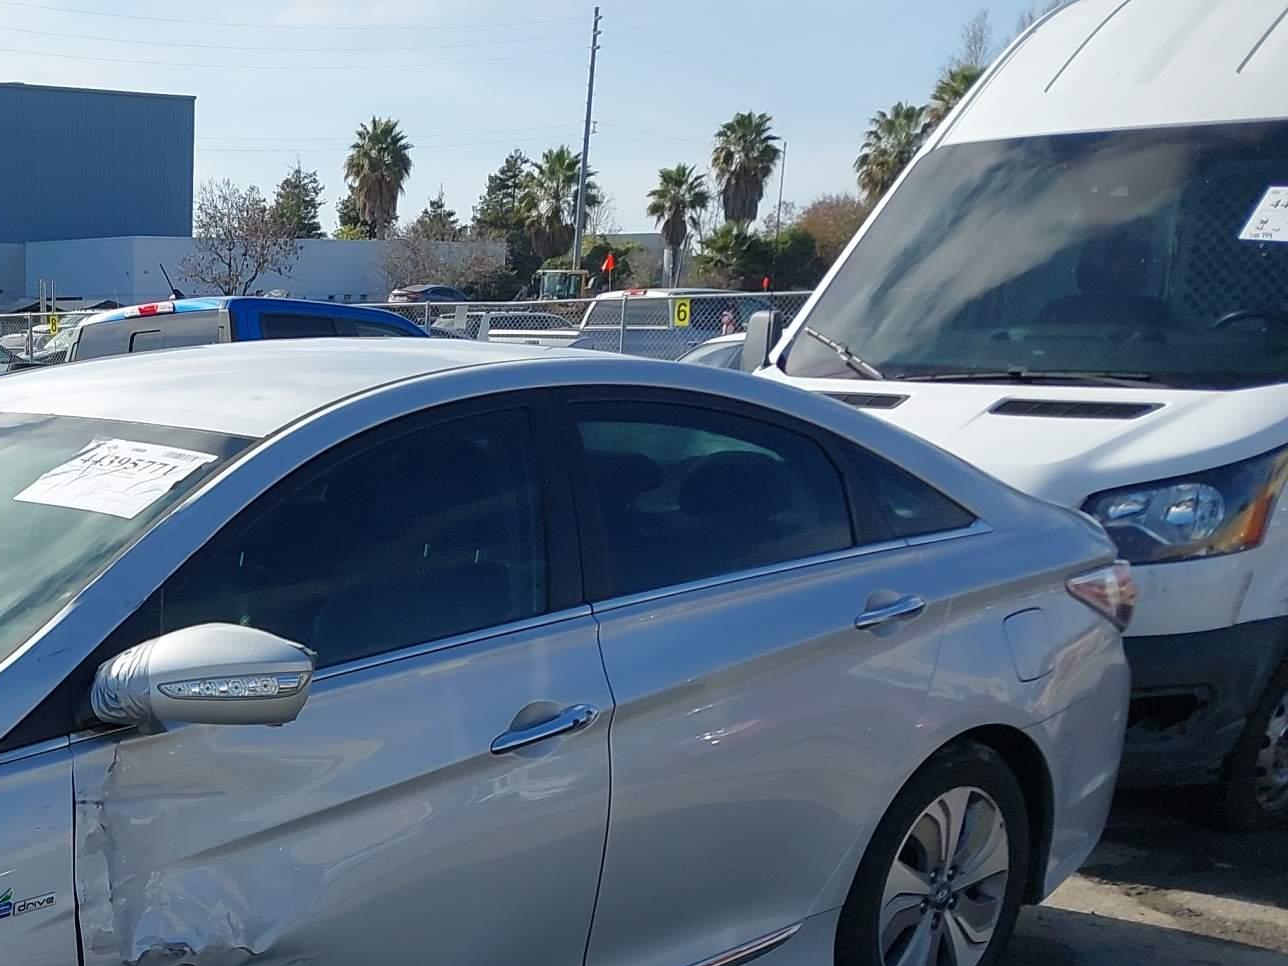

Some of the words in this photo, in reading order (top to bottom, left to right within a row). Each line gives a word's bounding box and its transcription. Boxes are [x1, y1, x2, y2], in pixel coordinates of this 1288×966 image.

[676, 302, 688, 322] 6
[51, 317, 57, 332] 8
[80, 453, 179, 477] 44395771
[16, 895, 55, 913] drive
